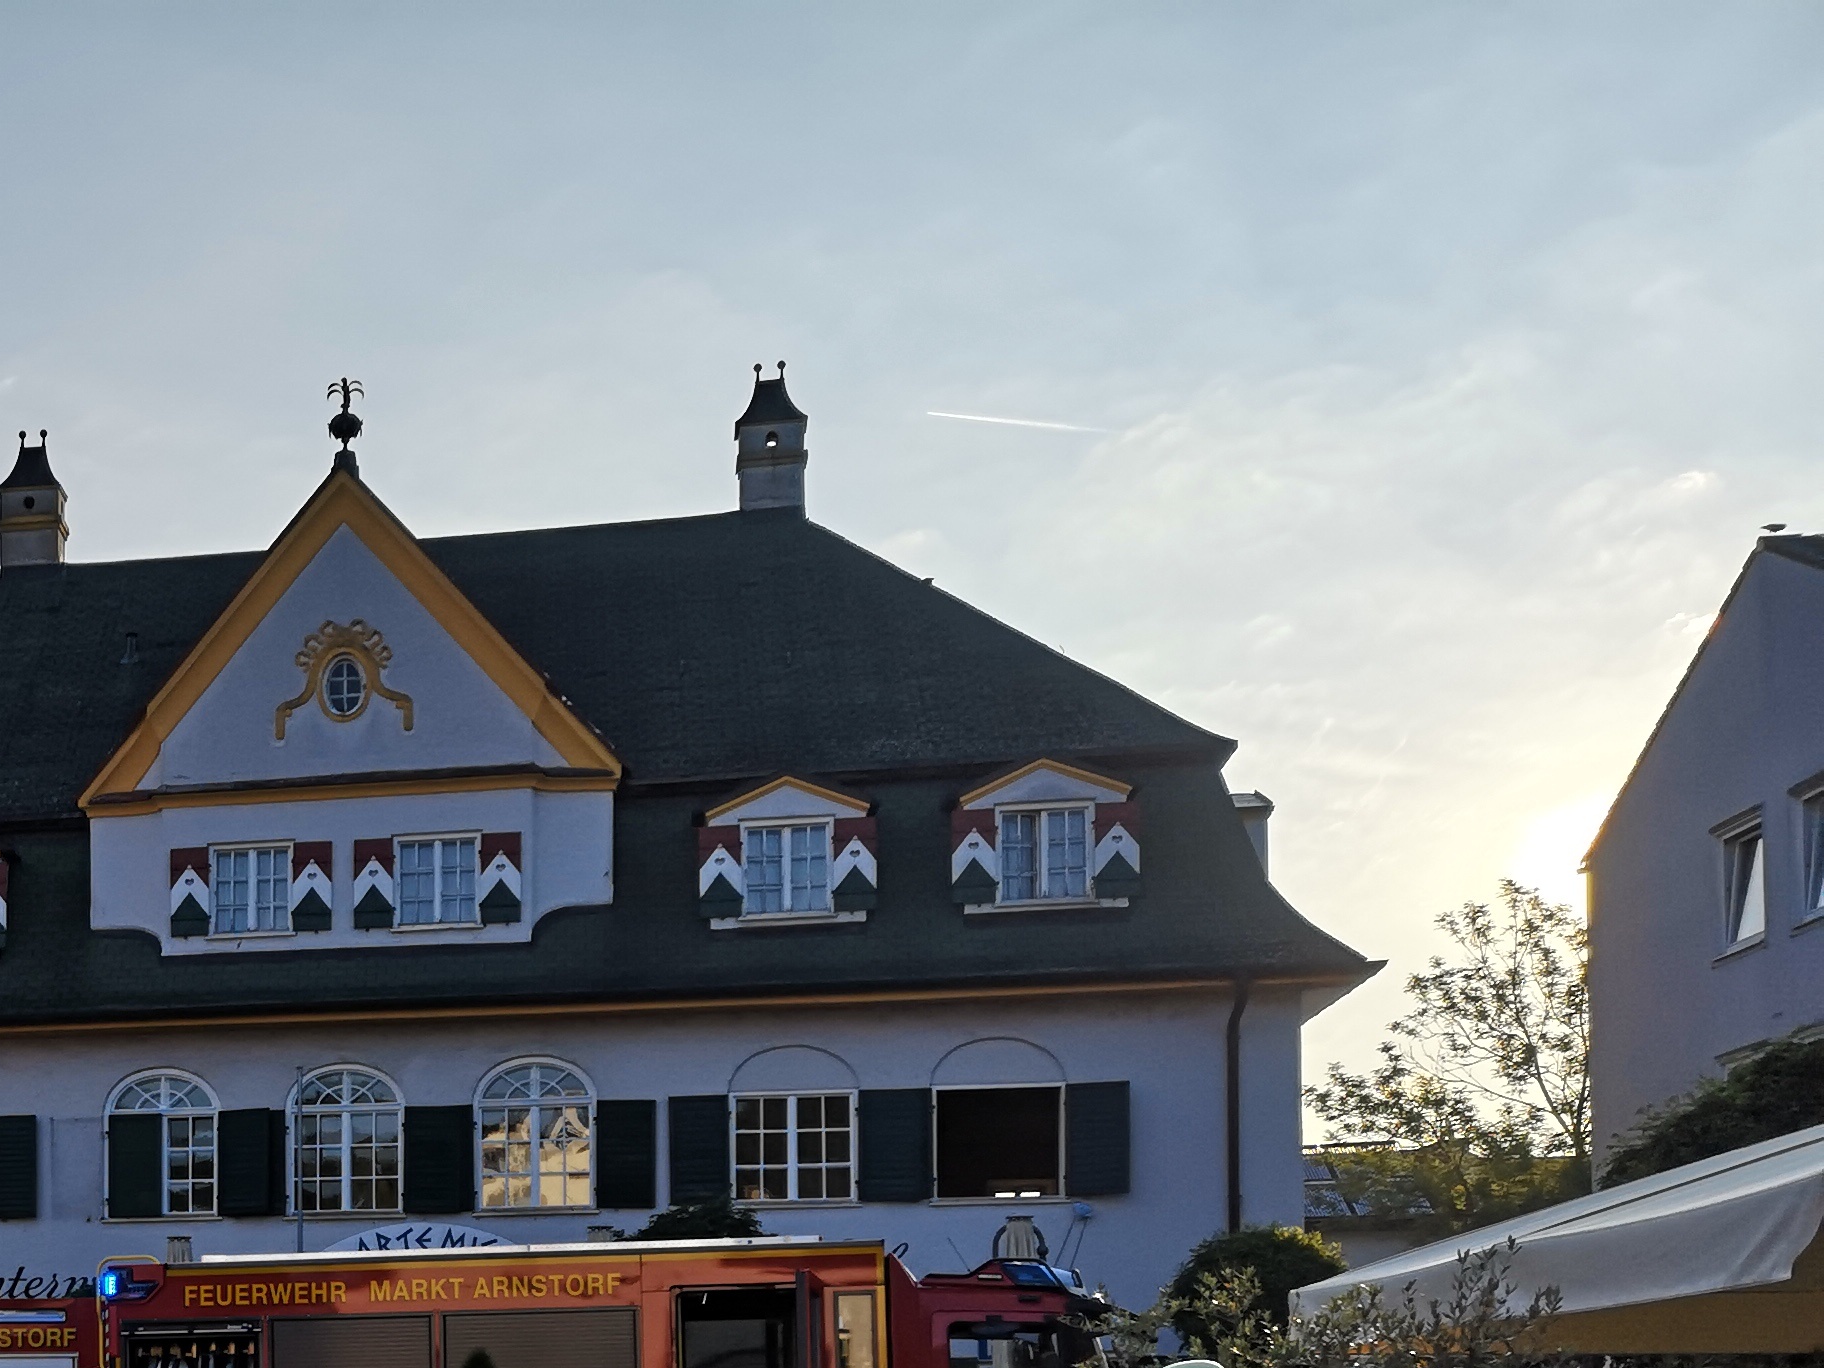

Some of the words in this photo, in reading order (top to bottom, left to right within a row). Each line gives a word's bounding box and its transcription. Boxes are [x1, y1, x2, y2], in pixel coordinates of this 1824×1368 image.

[358, 1227, 498, 1252] ARTEM
[183, 1281, 347, 1307] FEUERWEHR
[369, 1277, 463, 1303] MARKT
[473, 1273, 622, 1299] ARNSTORF
